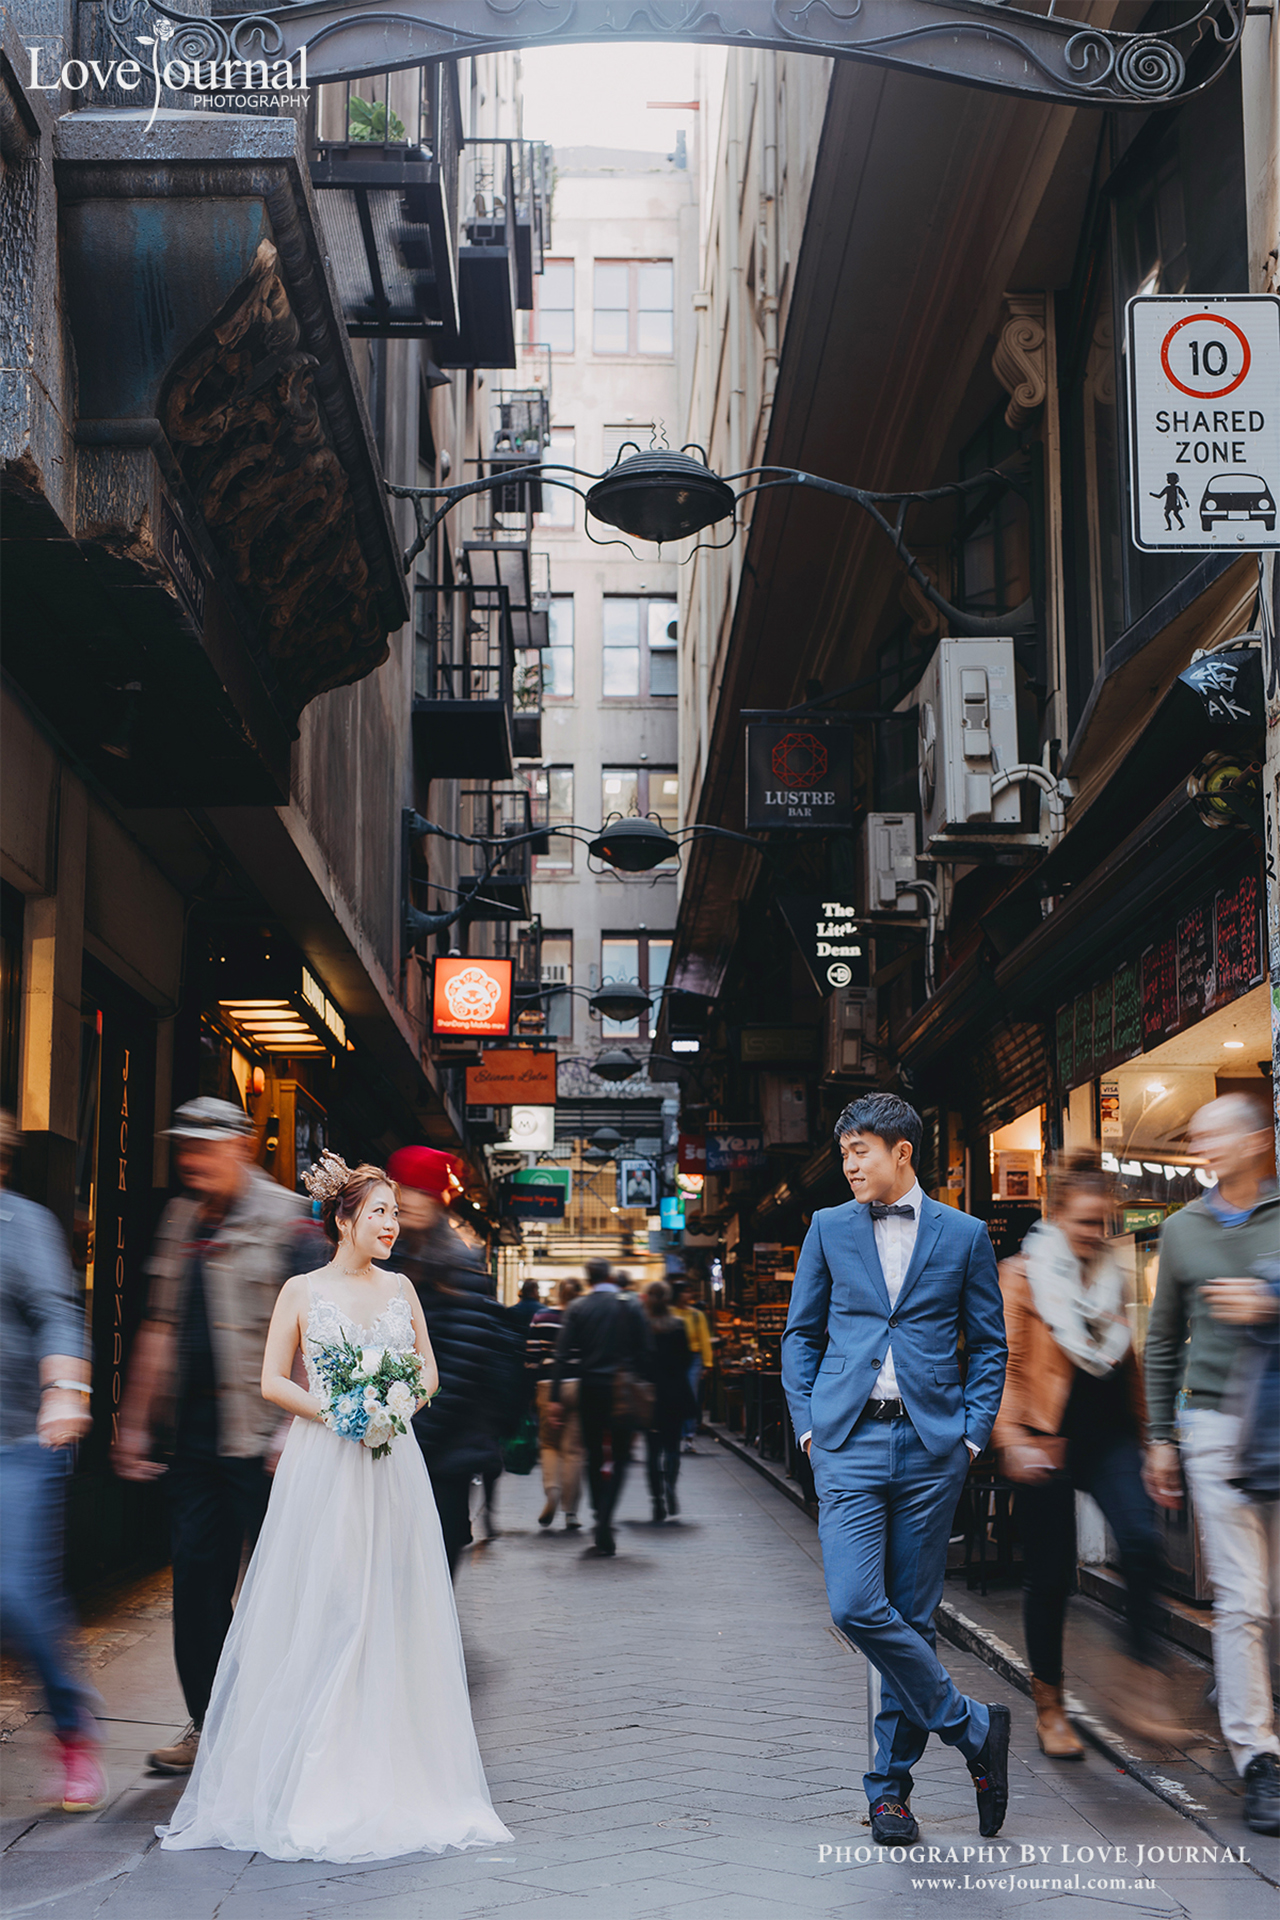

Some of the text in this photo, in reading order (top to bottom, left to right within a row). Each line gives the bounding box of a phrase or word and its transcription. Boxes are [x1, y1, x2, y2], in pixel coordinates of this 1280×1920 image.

[1188, 340, 1228, 377] 10
[1155, 410, 1265, 433] SHARED
[1175, 441, 1247, 464] ZONE
[764, 791, 835, 805] LUSTRE
[788, 807, 813, 817] BAR
[822, 902, 855, 917] The
[816, 942, 862, 957] Denn
[118, 1049, 131, 1192] JACK
[714, 1135, 760, 1151] Yen
[110, 1216, 126, 1446] LONDON
